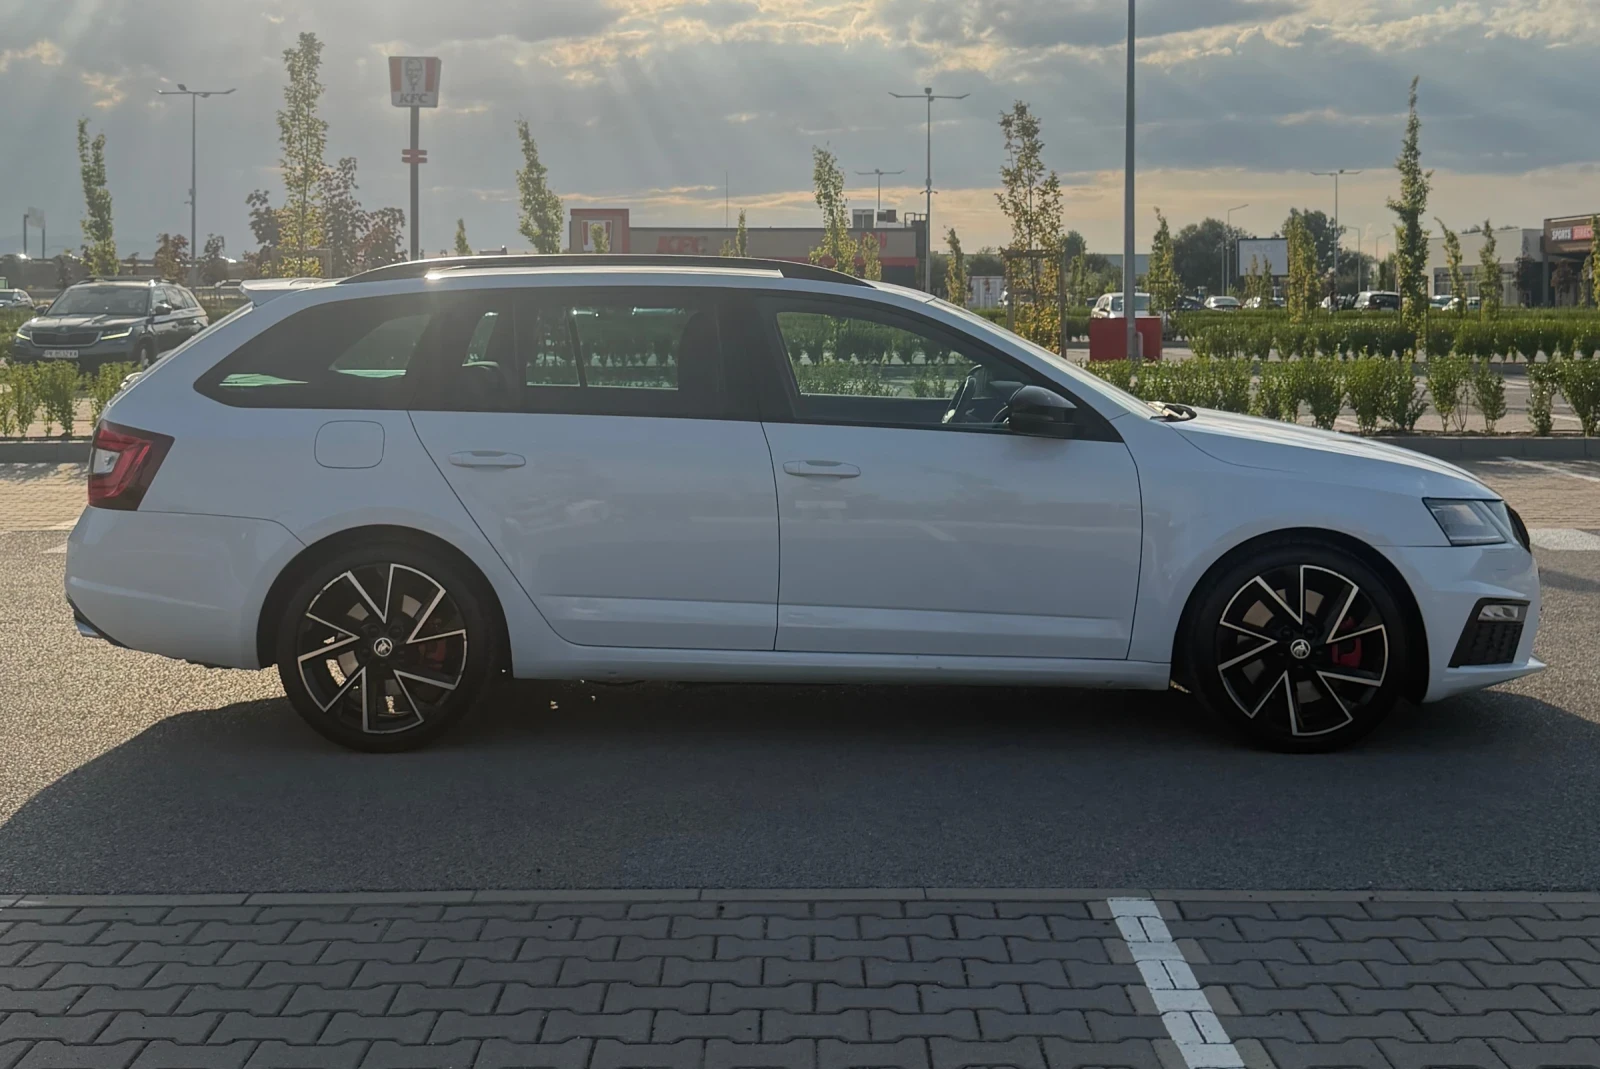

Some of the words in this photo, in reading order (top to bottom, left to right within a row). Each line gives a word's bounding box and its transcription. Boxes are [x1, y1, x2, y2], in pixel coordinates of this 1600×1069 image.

[400, 93, 429, 103] KFC
[1552, 229, 1571, 240] SPORTS
[657, 236, 708, 254] KFC
